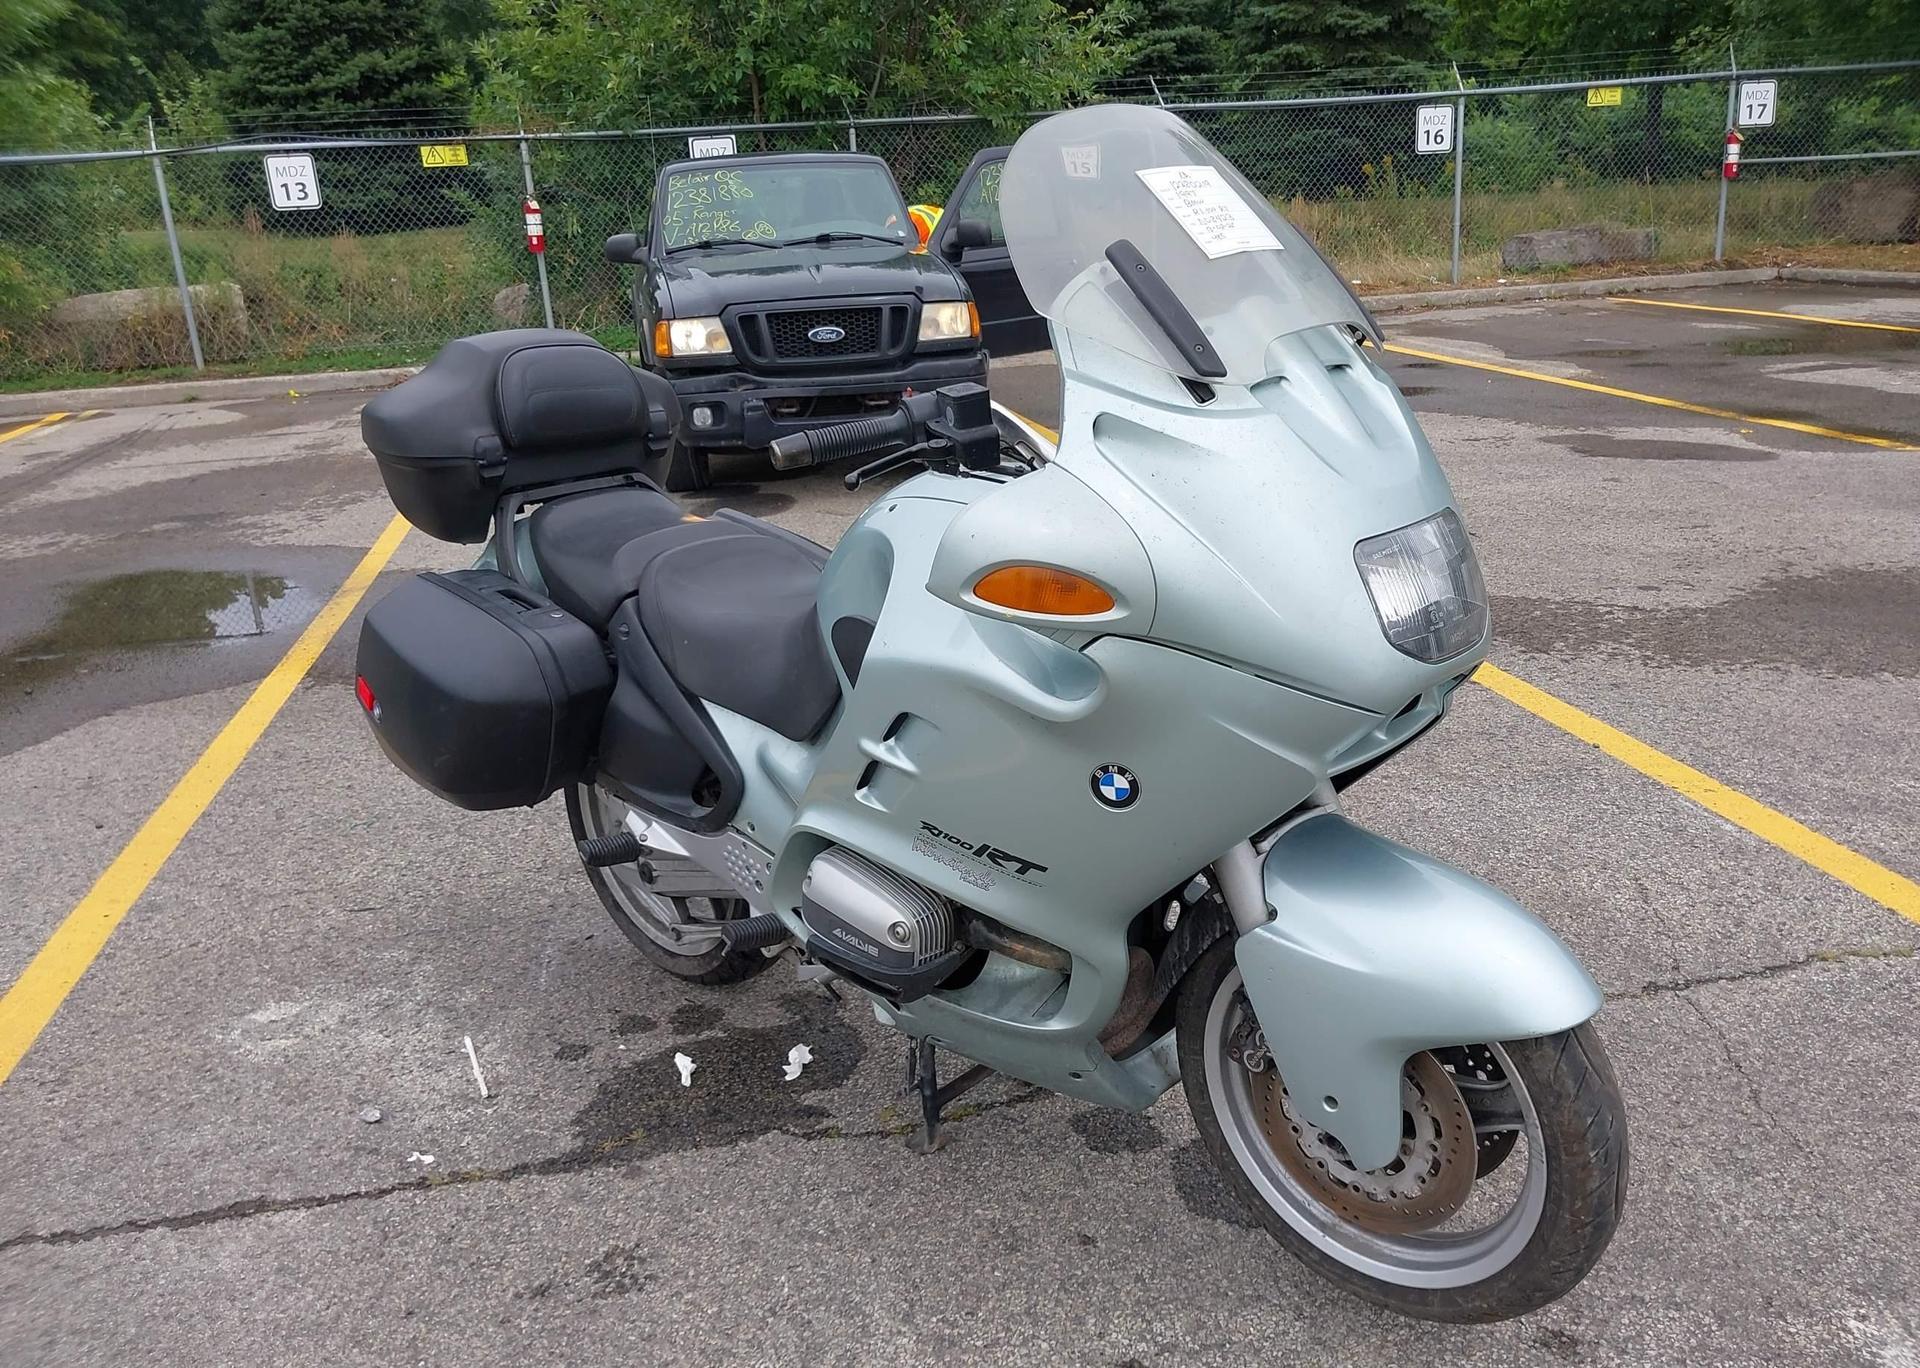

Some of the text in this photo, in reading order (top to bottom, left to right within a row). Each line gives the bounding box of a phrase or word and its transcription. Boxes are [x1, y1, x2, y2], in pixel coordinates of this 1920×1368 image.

[1745, 90, 1770, 100] MDZ
[1746, 103, 1768, 119] 17
[1422, 114, 1447, 126] MDZ
[1423, 129, 1445, 146] 16
[275, 165, 308, 178] MDZ
[1070, 161, 1092, 175] 15
[280, 182, 309, 201] 13
[816, 330, 837, 340] Ford
[1095, 765, 1134, 781] BMW
